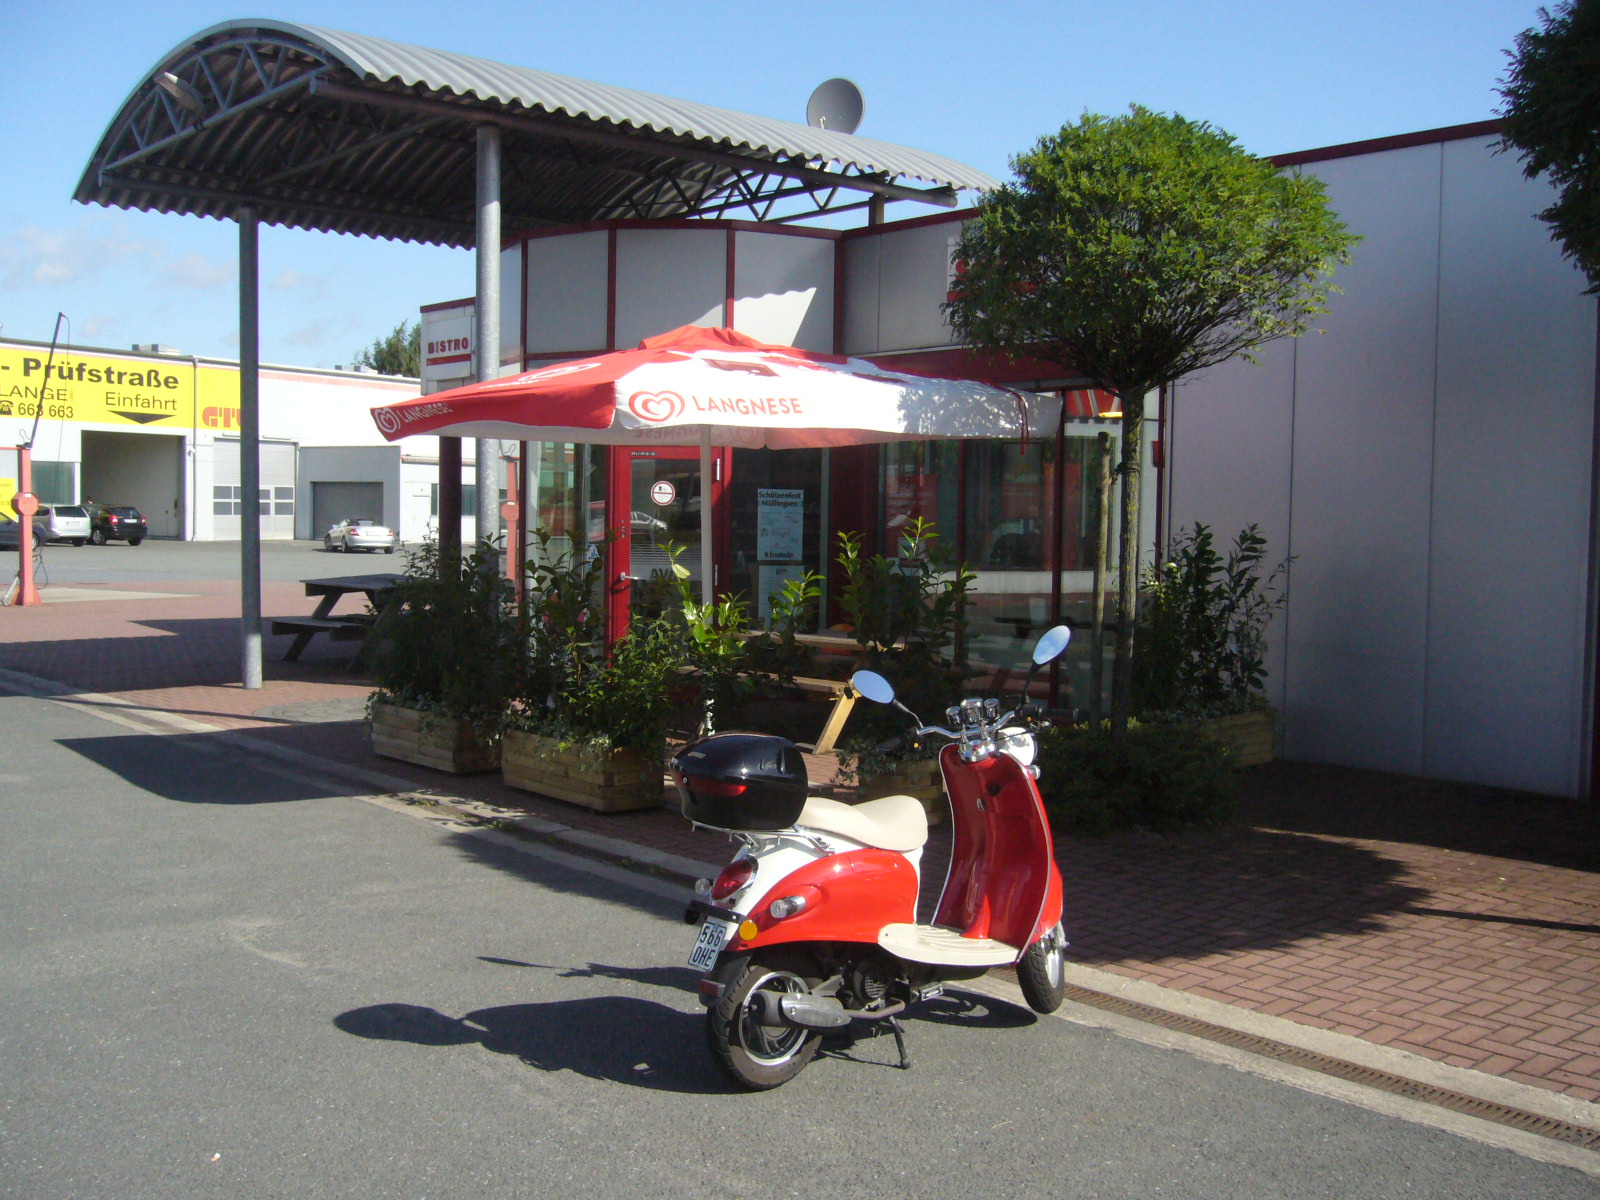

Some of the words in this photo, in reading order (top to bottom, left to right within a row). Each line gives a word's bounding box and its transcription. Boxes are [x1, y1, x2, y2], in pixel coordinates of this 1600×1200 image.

[427, 336, 469, 354] BISTRO
[23, 357, 179, 389] Prüfstraße
[105, 391, 177, 410] Einfahrt
[692, 395, 803, 415] LANGNESE
[49, 404, 74, 418] 663
[759, 491, 801, 499] Schützenfest
[700, 925, 723, 947] 566
[692, 946, 716, 967] OHE
